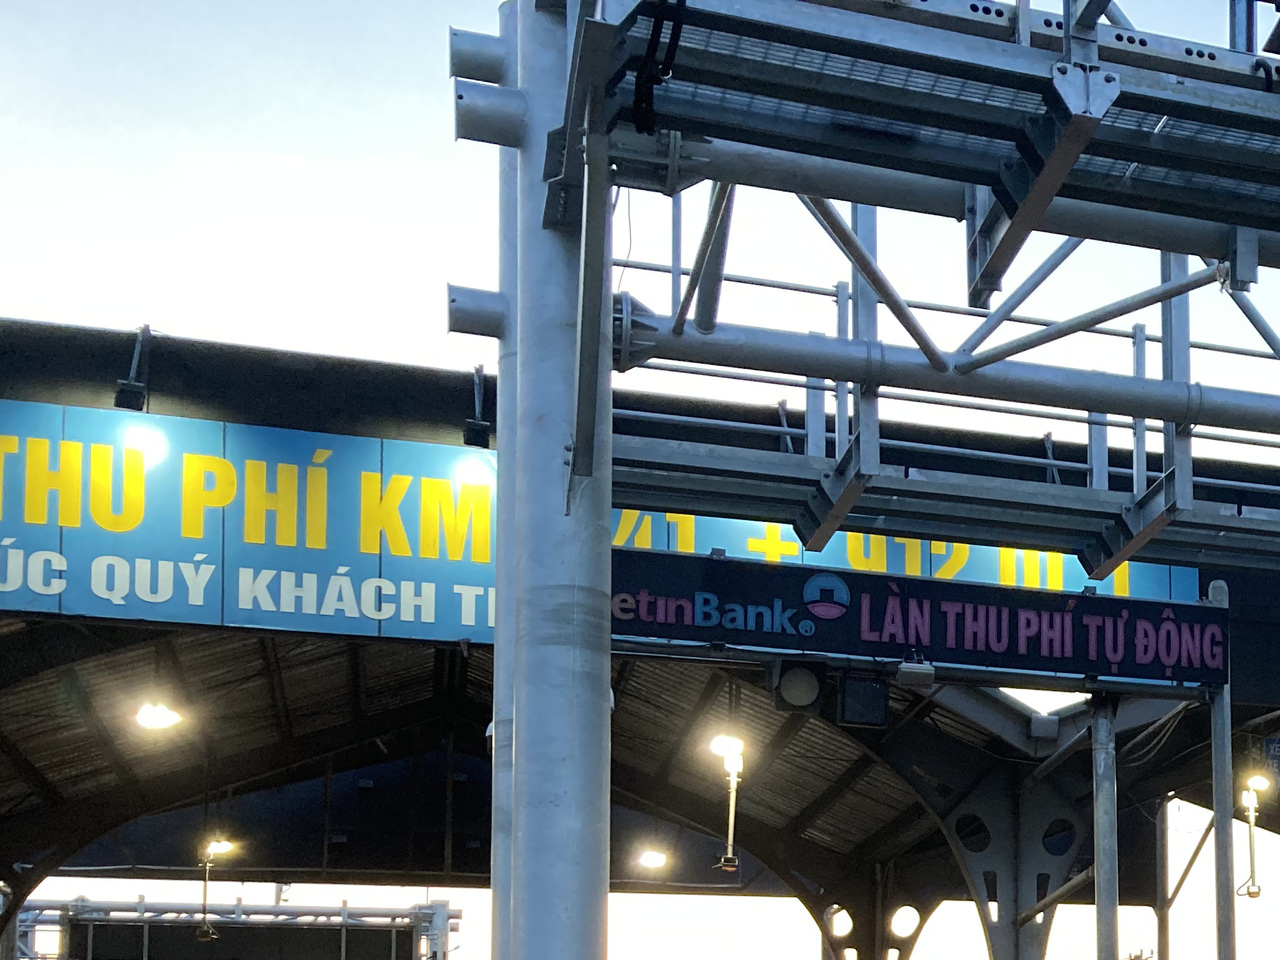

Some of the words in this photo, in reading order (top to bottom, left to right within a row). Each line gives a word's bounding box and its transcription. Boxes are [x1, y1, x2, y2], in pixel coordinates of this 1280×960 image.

[181, 449, 333, 550] PHÍ
[359, 471, 491, 563] KM
[91, 553, 216, 606] QUÝ
[238, 566, 435, 624] KHÁCH
[860, 582, 931, 646] LÀN
[941, 601, 1009, 653] THU
[1017, 600, 1073, 658] PHÍ
[1083, 608, 1128, 673] TỰ
[1135, 608, 1223, 677] ĐỘNG
[1268, 760, 1279, 772] XE
[1269, 744, 1280, 756] XE
